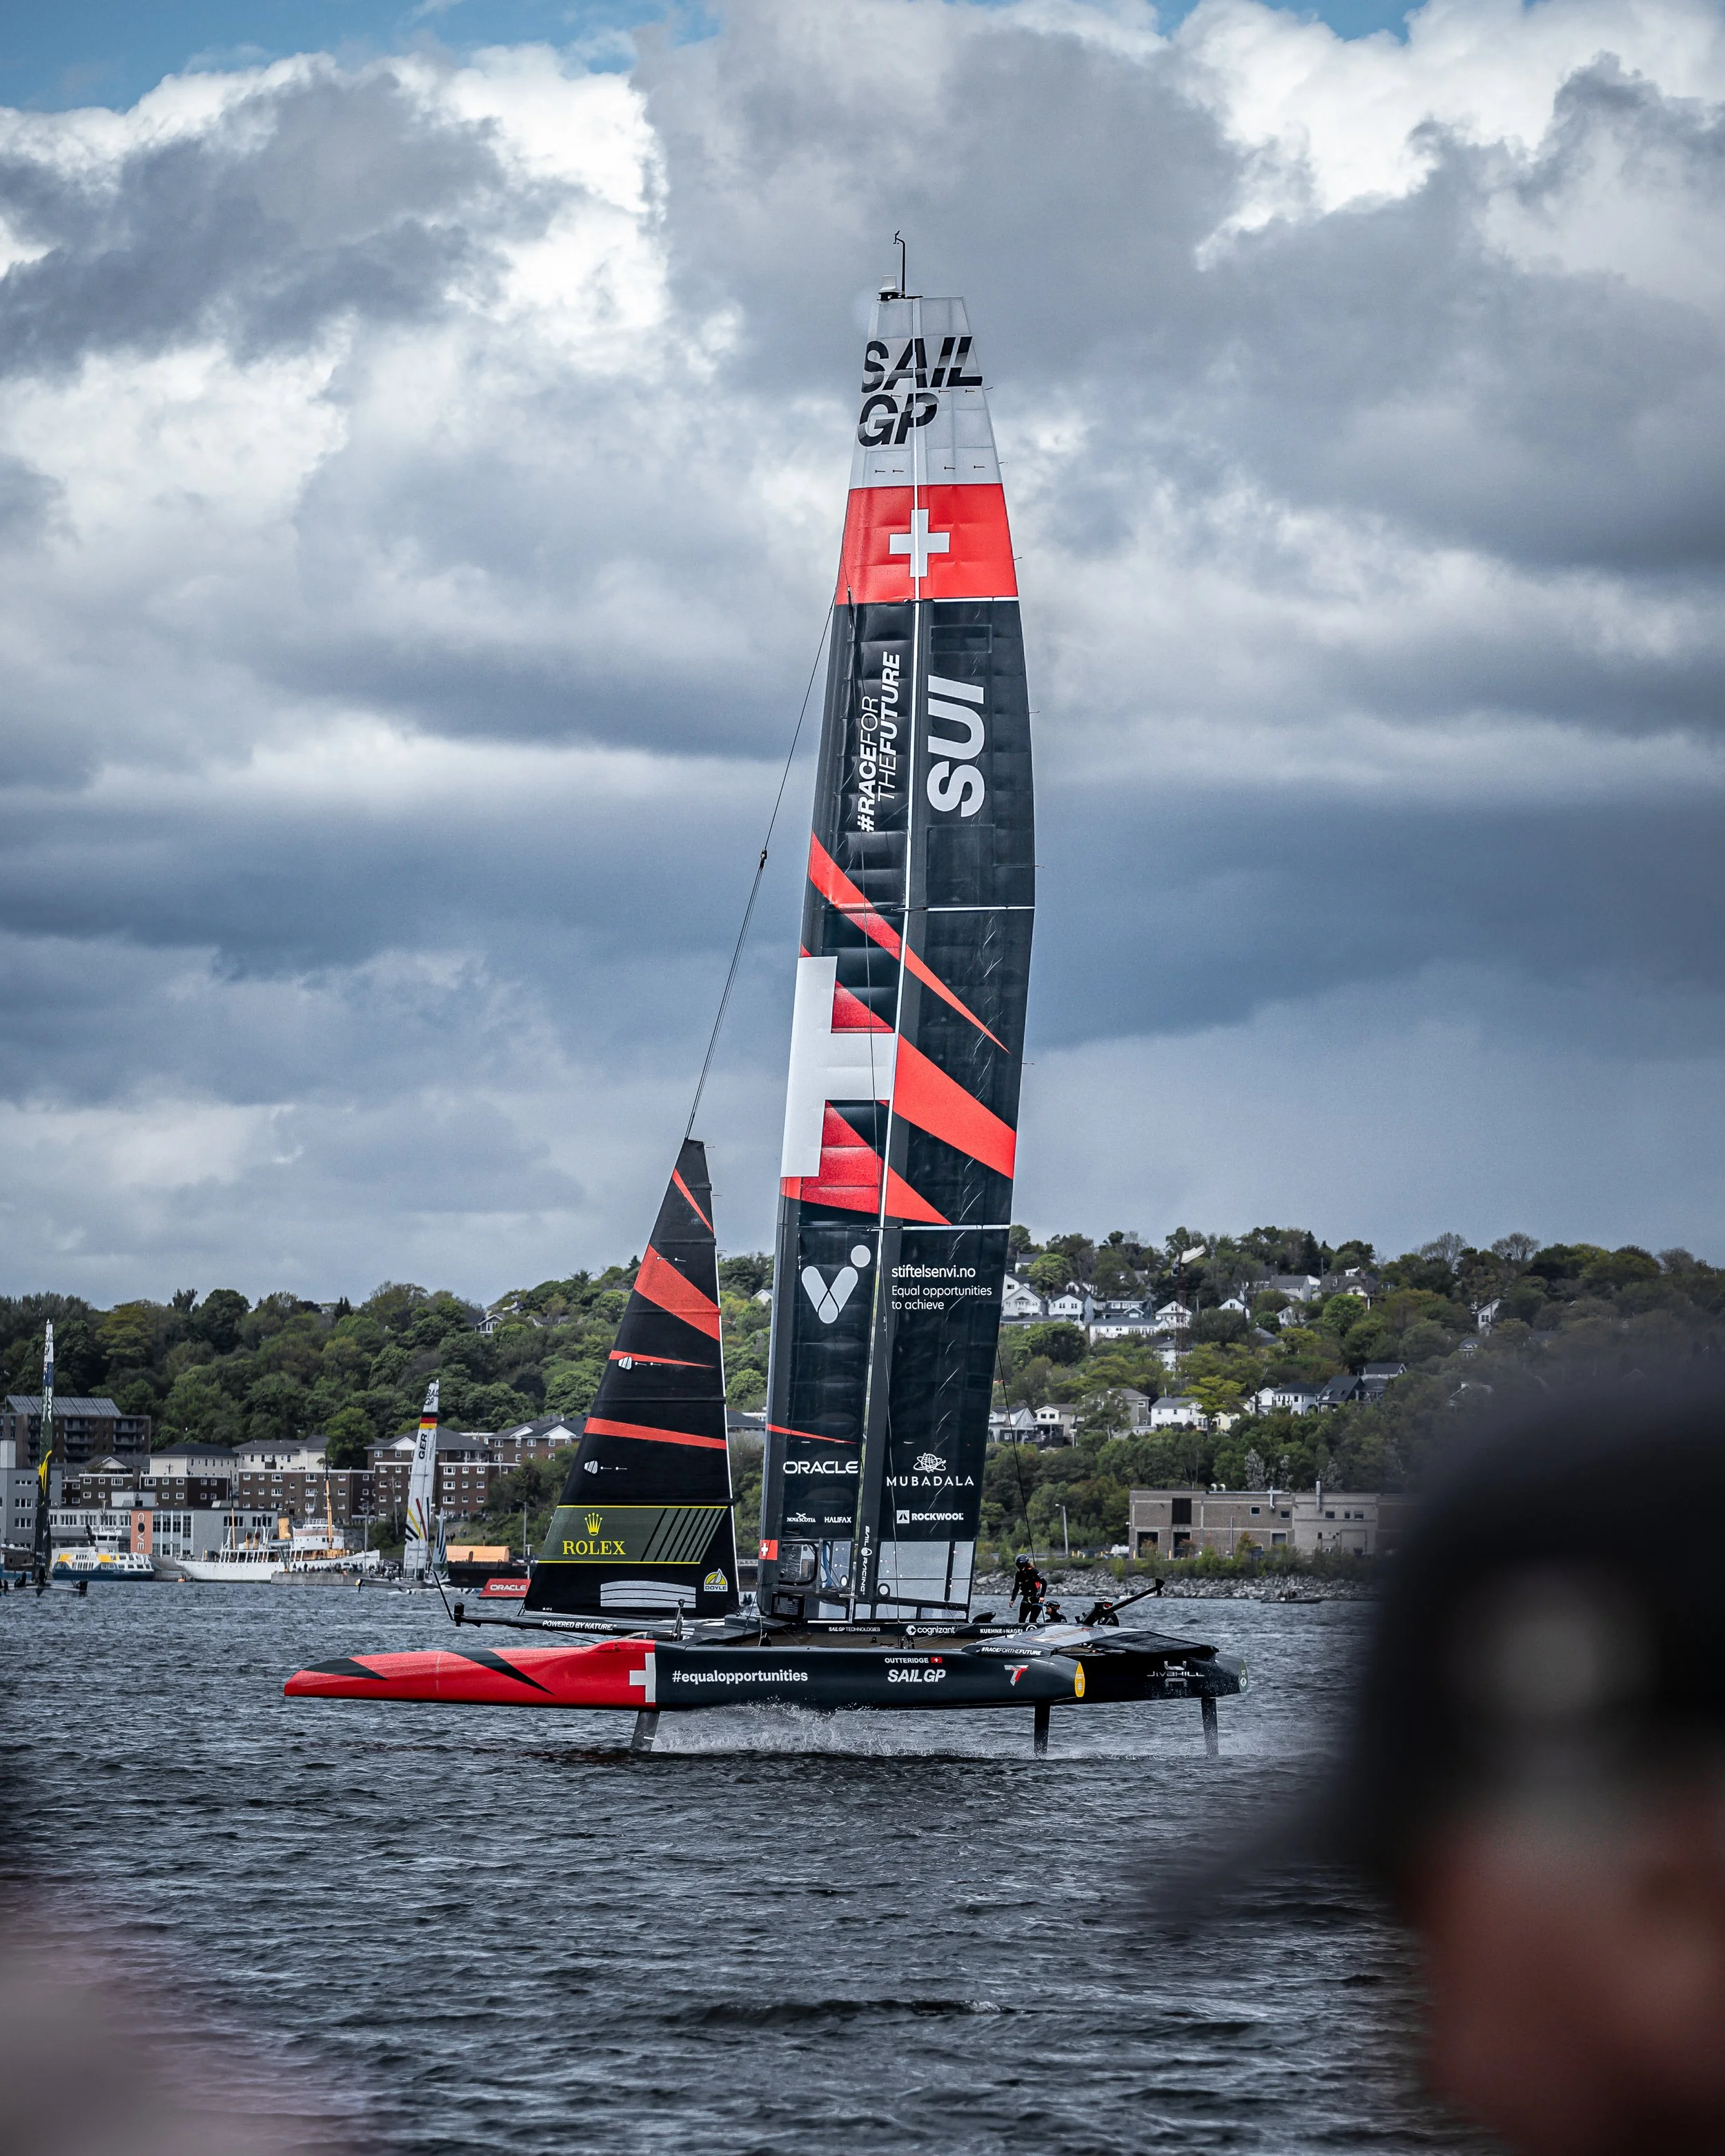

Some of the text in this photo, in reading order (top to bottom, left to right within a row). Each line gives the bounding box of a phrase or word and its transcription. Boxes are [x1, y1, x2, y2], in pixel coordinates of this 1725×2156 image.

[861, 336, 983, 393] SAIL
[858, 392, 940, 447] GP
[927, 675, 985, 818] SUI
[891, 1265, 976, 1278] stiftelsenvi.no
[891, 1285, 992, 1297] Equal opportunities
[891, 1299, 945, 1309] to achieve
[418, 1433, 427, 1459] GER
[782, 1461, 859, 1474] ORACLE
[886, 1476, 974, 1486] MUBADALA
[562, 1541, 626, 1555] ROLEX
[542, 1620, 575, 1628] POWERED
[917, 1626, 955, 1636] cognizant
[672, 1669, 808, 1685] #equalopportunities
